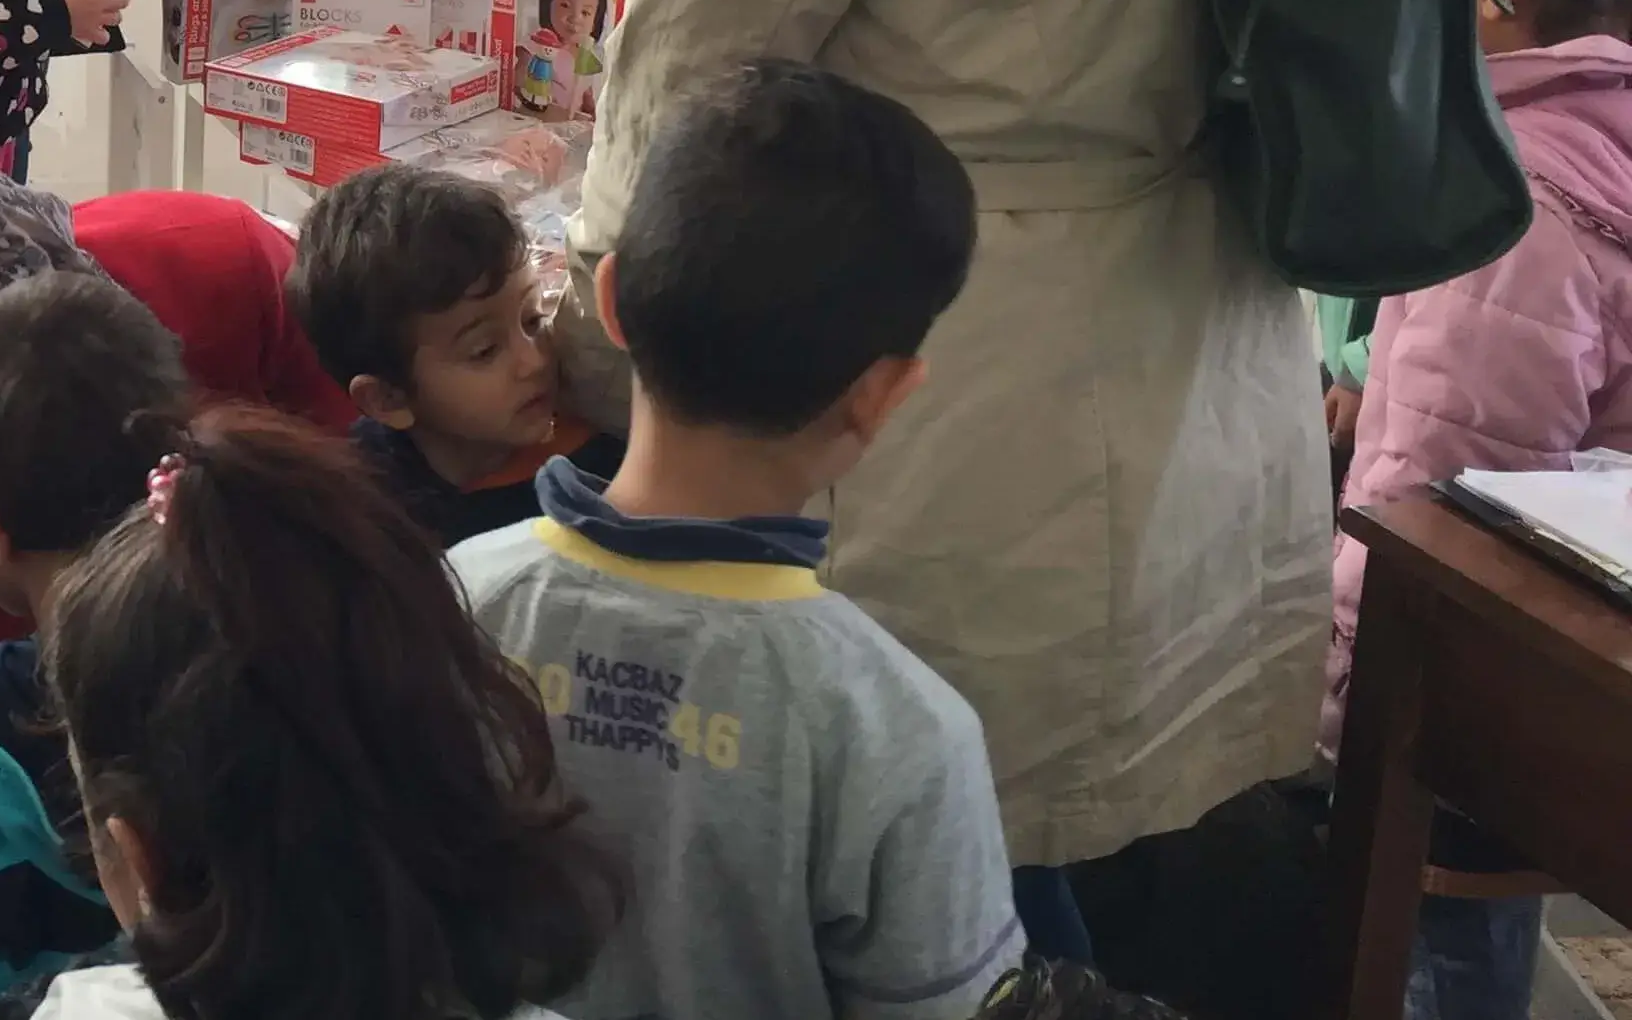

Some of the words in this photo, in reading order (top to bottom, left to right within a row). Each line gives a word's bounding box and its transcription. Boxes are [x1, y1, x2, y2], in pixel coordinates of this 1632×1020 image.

[299, 8, 362, 23] BLOCKS
[585, 686, 668, 730] MUSIC
[670, 701, 742, 769] 46
